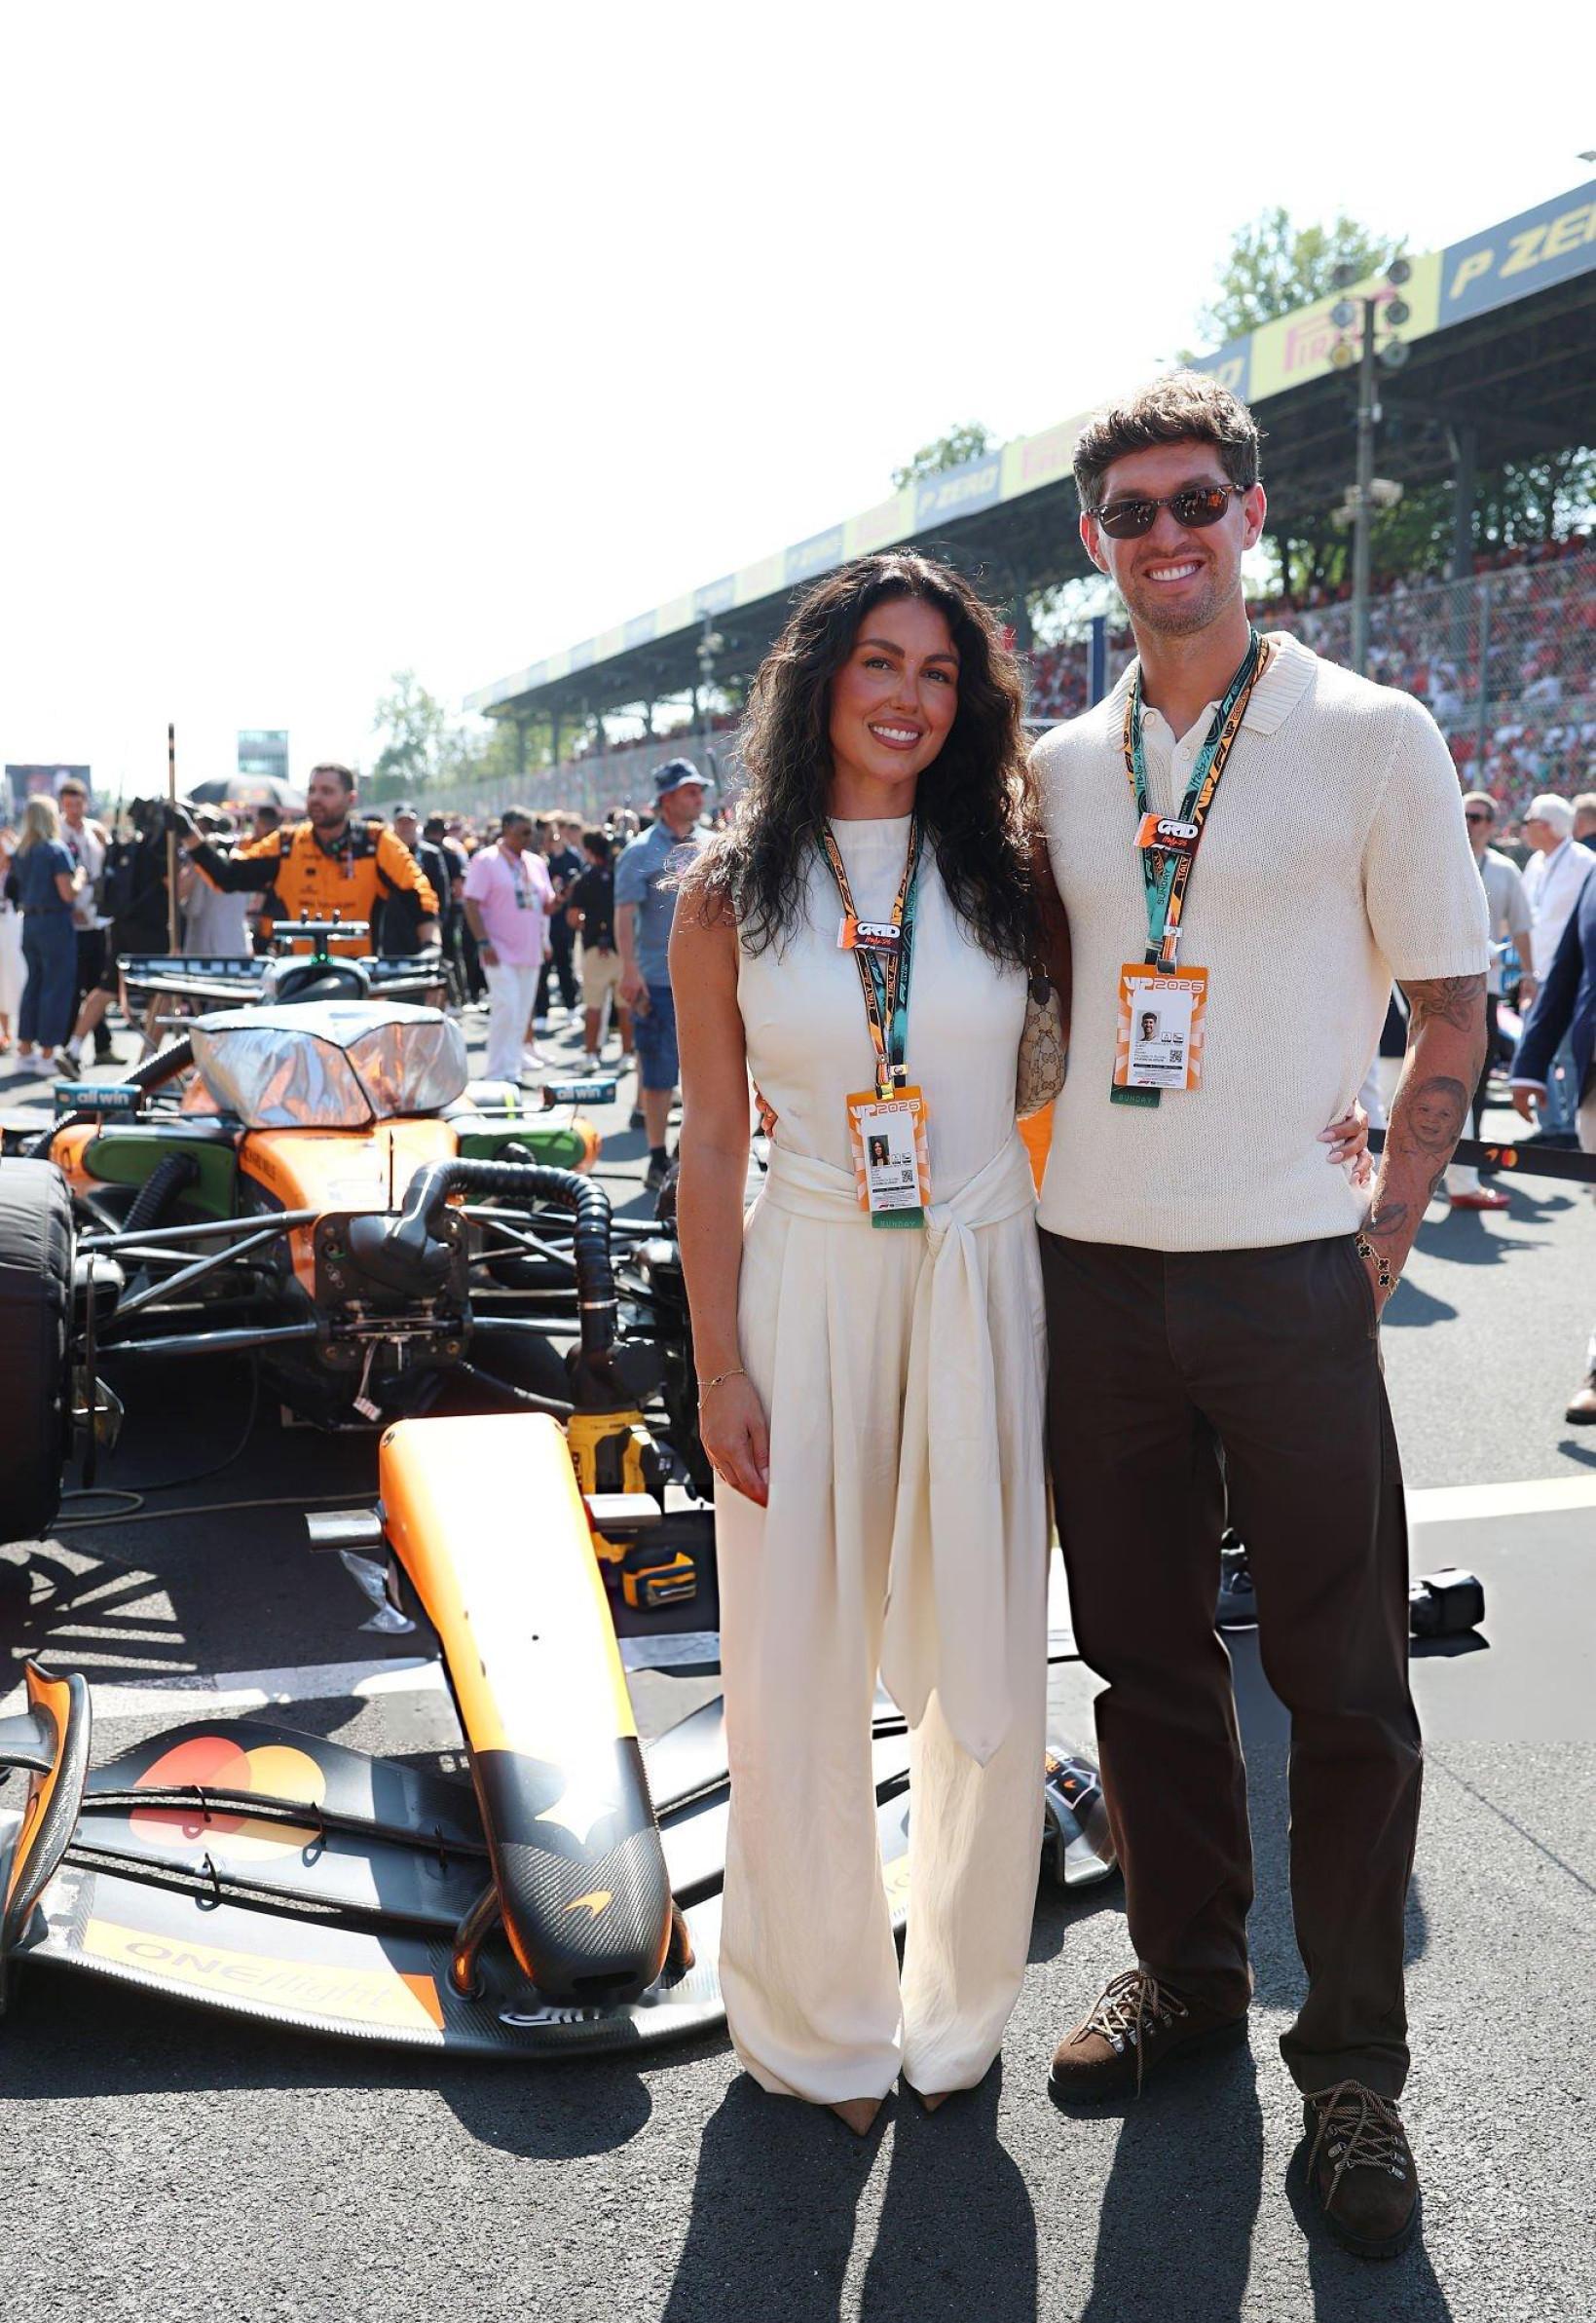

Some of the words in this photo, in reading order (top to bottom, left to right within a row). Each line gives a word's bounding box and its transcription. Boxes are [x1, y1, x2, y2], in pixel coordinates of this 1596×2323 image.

[1449, 247, 1495, 300] P
[1157, 818, 1199, 839] GRID
[857, 922, 901, 938] GRID
